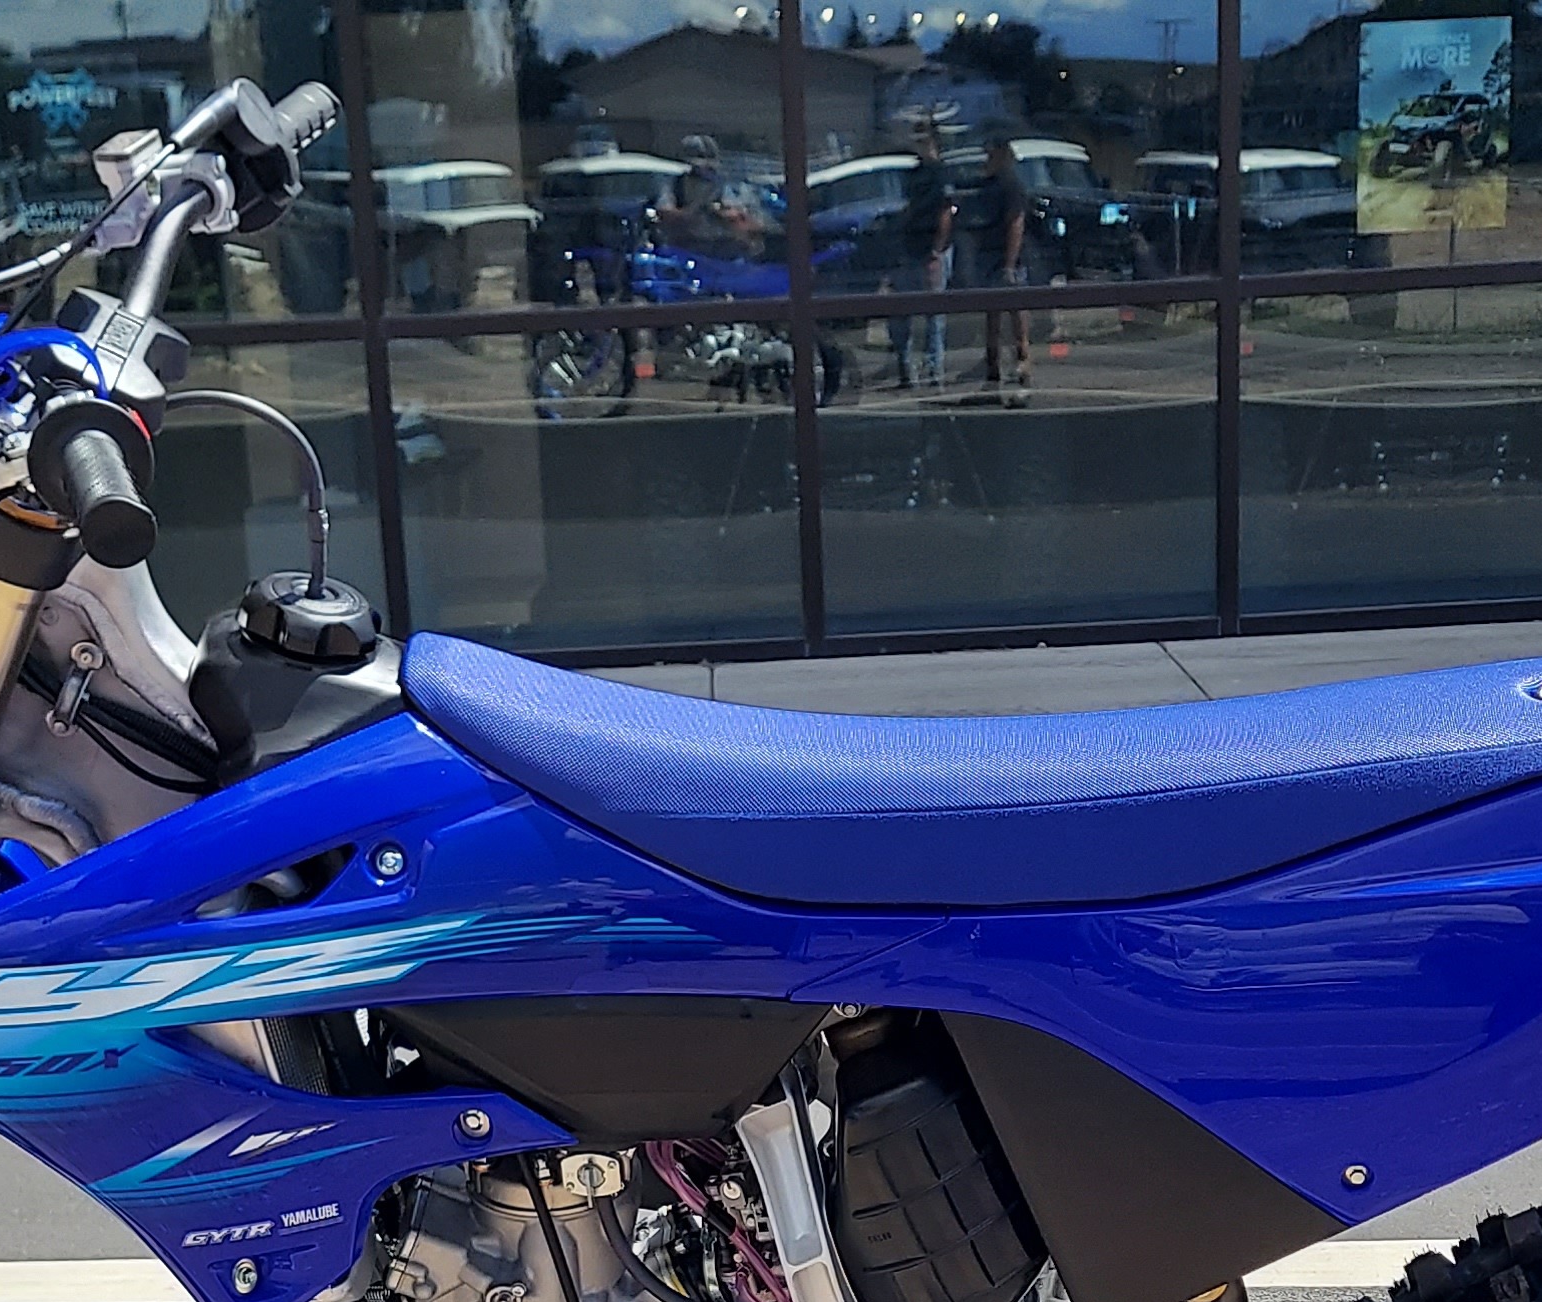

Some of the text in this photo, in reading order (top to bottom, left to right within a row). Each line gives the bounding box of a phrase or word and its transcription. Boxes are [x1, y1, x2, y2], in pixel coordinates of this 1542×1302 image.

[1401, 45, 1471, 69] MORE
[280, 1203, 339, 1228] YAMALUBE
[181, 1220, 275, 1248] GYTR
